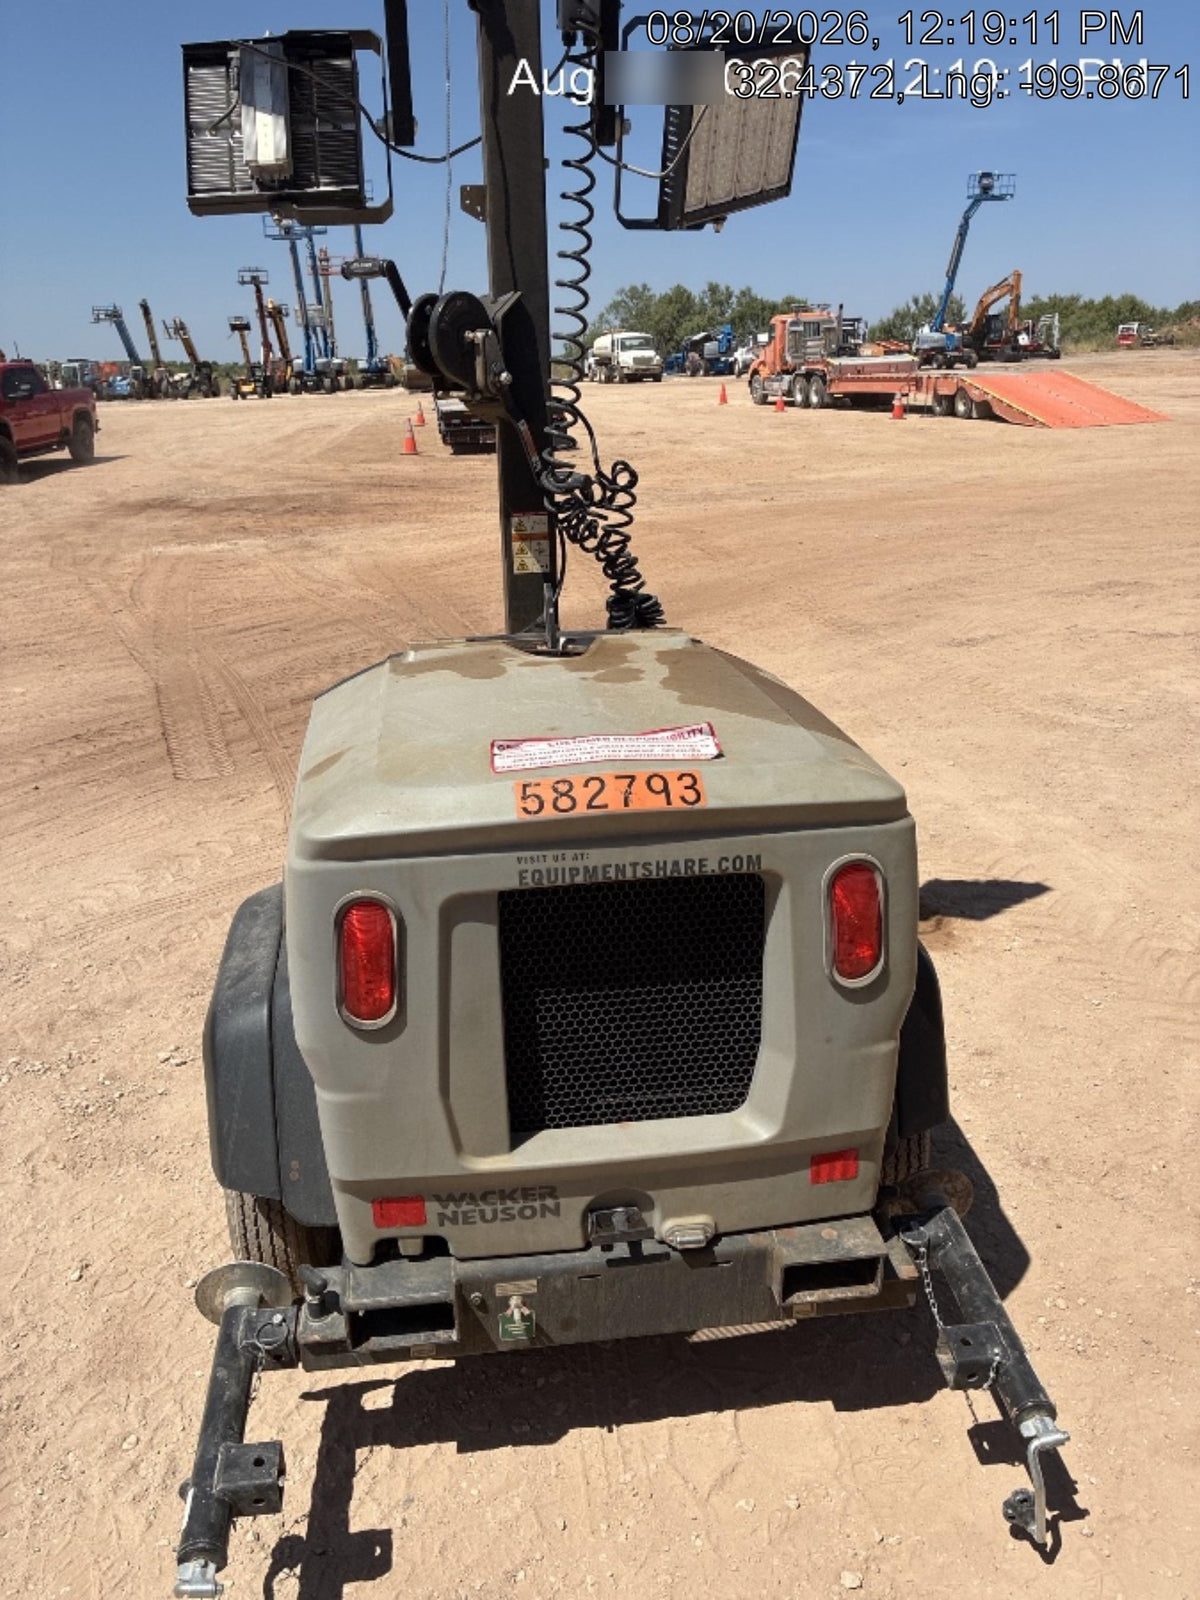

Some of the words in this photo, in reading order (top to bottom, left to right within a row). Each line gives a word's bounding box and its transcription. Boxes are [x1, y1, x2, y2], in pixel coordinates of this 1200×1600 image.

[520, 772, 702, 816] 582793
[517, 854, 547, 865] VISIT
[552, 853, 566, 863] US
[572, 852, 589, 861] AT:
[518, 854, 762, 887] EQUIPMENTSHARE.COM
[432, 1185, 560, 1209] WACKER
[437, 1201, 560, 1227] NEUSON
